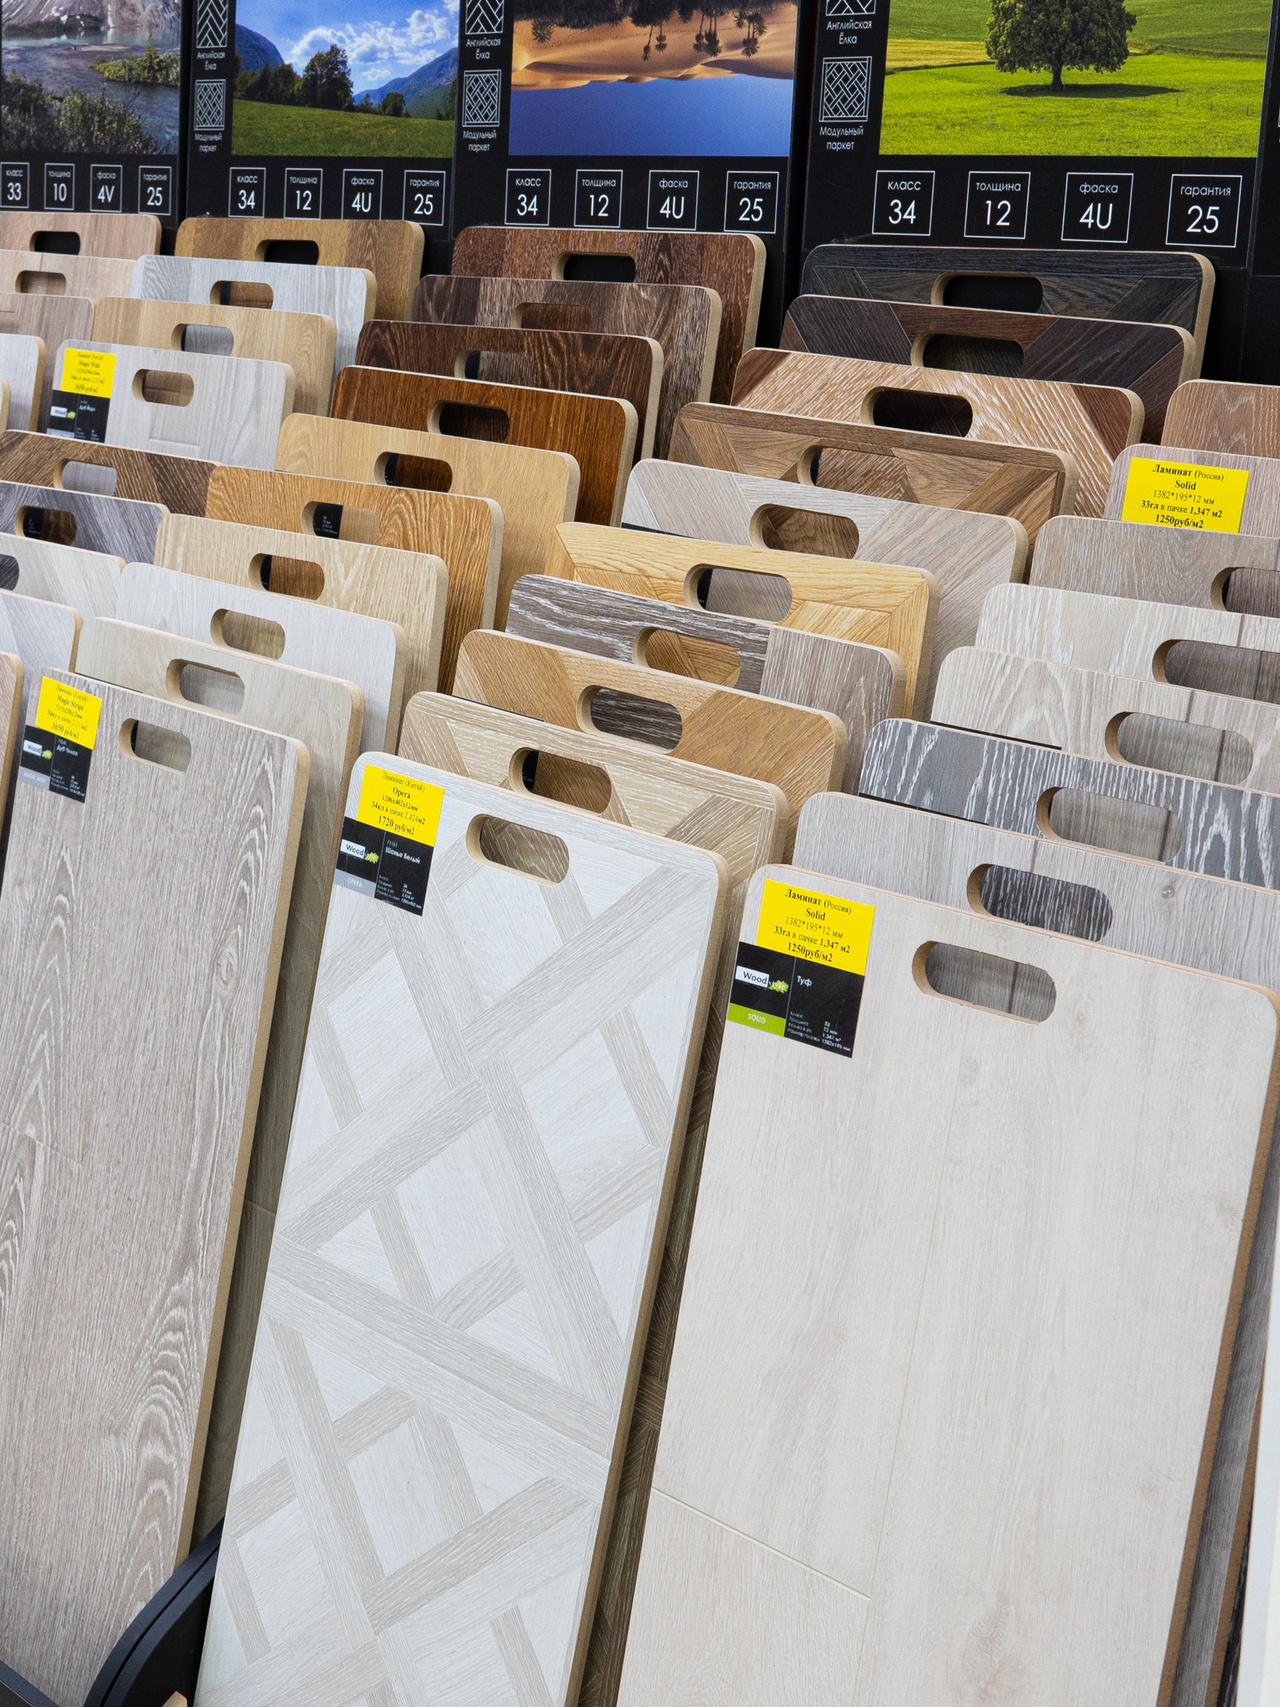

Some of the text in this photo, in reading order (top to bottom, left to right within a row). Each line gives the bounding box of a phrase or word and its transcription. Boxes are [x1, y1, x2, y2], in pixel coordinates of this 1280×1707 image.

[826, 19, 872, 32] Английская
[466, 37, 501, 48] Английская
[838, 32, 858, 44] Ёлка
[476, 49, 490, 60] Ёлка
[463, 130, 497, 140] Модульный
[820, 126, 864, 138] Модульный
[468, 142, 490, 152] паркет
[826, 140, 854, 152] паркет
[236, 175, 440, 188] класс толщина фаска гарантия
[516, 177, 772, 190] класс толщина фаска гарантия
[887, 178, 1232, 198] класс толщина фаска гарантия
[7, 183, 22, 201] 33
[53, 183, 67, 202] 10
[147, 187, 163, 206] 25
[238, 190, 256, 210] 34
[296, 190, 312, 210] 12
[414, 194, 434, 216] 25
[517, 194, 538, 216] 34
[589, 194, 609, 216] 12
[739, 198, 763, 222] 25
[888, 200, 916, 225] 34
[985, 200, 1010, 227] 12
[1186, 206, 1220, 234] 25
[1152, 464, 1224, 482] Ламинат (Россия)
[1174, 480, 1196, 490] Solid
[1166, 504, 1188, 514] пачке
[1189, 508, 1210, 517] 1,347
[1211, 510, 1222, 518] м2
[1155, 514, 1204, 529] 1250руб/м2
[392, 786, 411, 799] Opera
[378, 815, 394, 828] 1720
[784, 888, 852, 914] Ламинат (Россия)
[805, 908, 826, 921] Solid
[832, 930, 843, 940] мм
[798, 934, 818, 945] пачке
[820, 938, 839, 950] 1,347
[840, 944, 850, 954] м2
[787, 942, 833, 963] 1250руб/м2
[796, 975, 813, 988] Туф
[748, 1012, 766, 1024] SOLID
